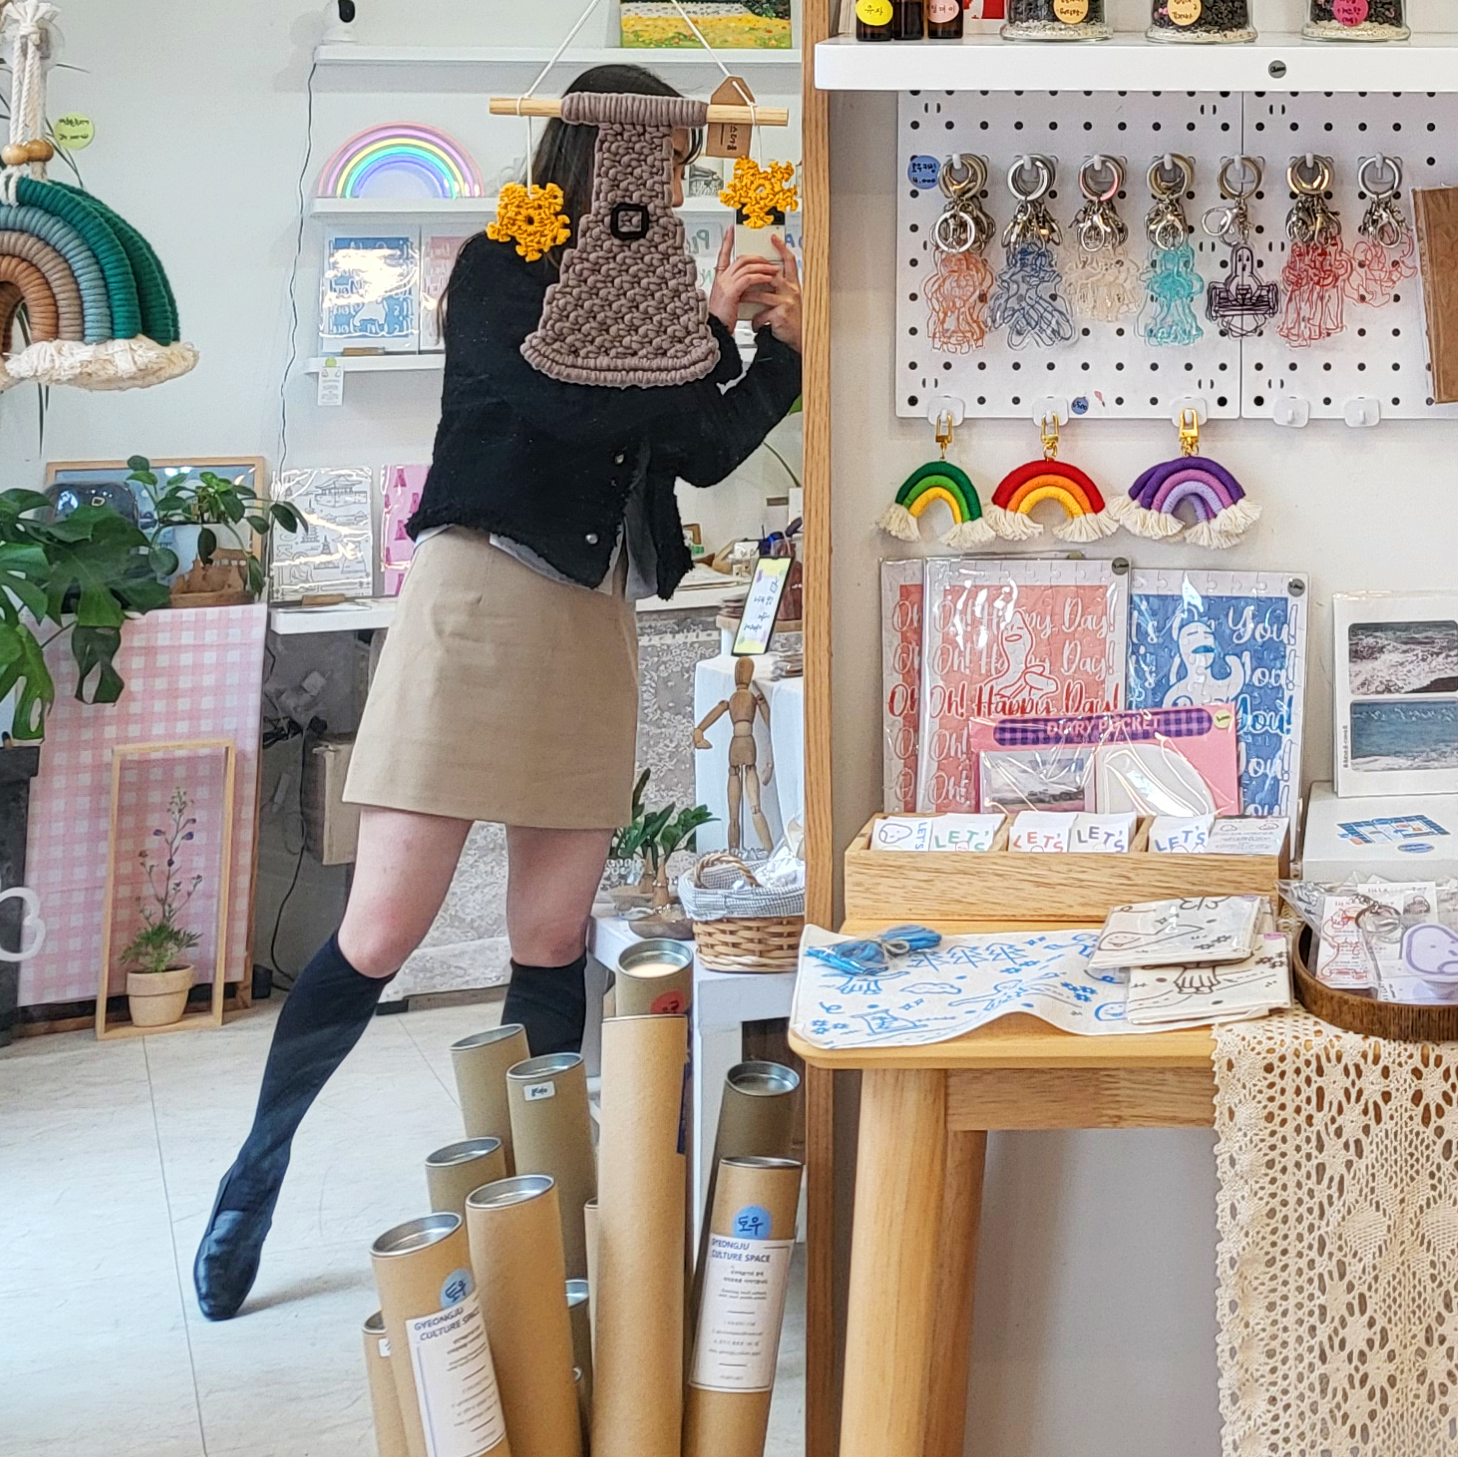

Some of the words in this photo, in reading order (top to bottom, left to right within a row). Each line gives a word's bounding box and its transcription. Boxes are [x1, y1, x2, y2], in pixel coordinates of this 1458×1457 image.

[1062, 595, 1117, 640] Day!
[1228, 603, 1298, 646] You!
[932, 640, 972, 676] Oh!
[1061, 640, 1117, 682] Day!
[929, 681, 967, 720] Oh!
[1046, 719, 1096, 736] DIARY
[929, 726, 968, 762] Oh!
[916, 821, 927, 851] LET'S
[934, 828, 990, 853] LET'S
[1012, 831, 1064, 853] LET'S
[1076, 826, 1126, 853] LET'S
[1155, 824, 1207, 853] LET'S
[738, 1215, 764, 1236] 도우
[711, 1237, 751, 1251] GYEONGJU
[711, 1249, 744, 1262] CULTURE
[744, 1251, 772, 1264] SPACE
[413, 1307, 464, 1331] GYEONGJU
[420, 1319, 462, 1341] CULTURE
